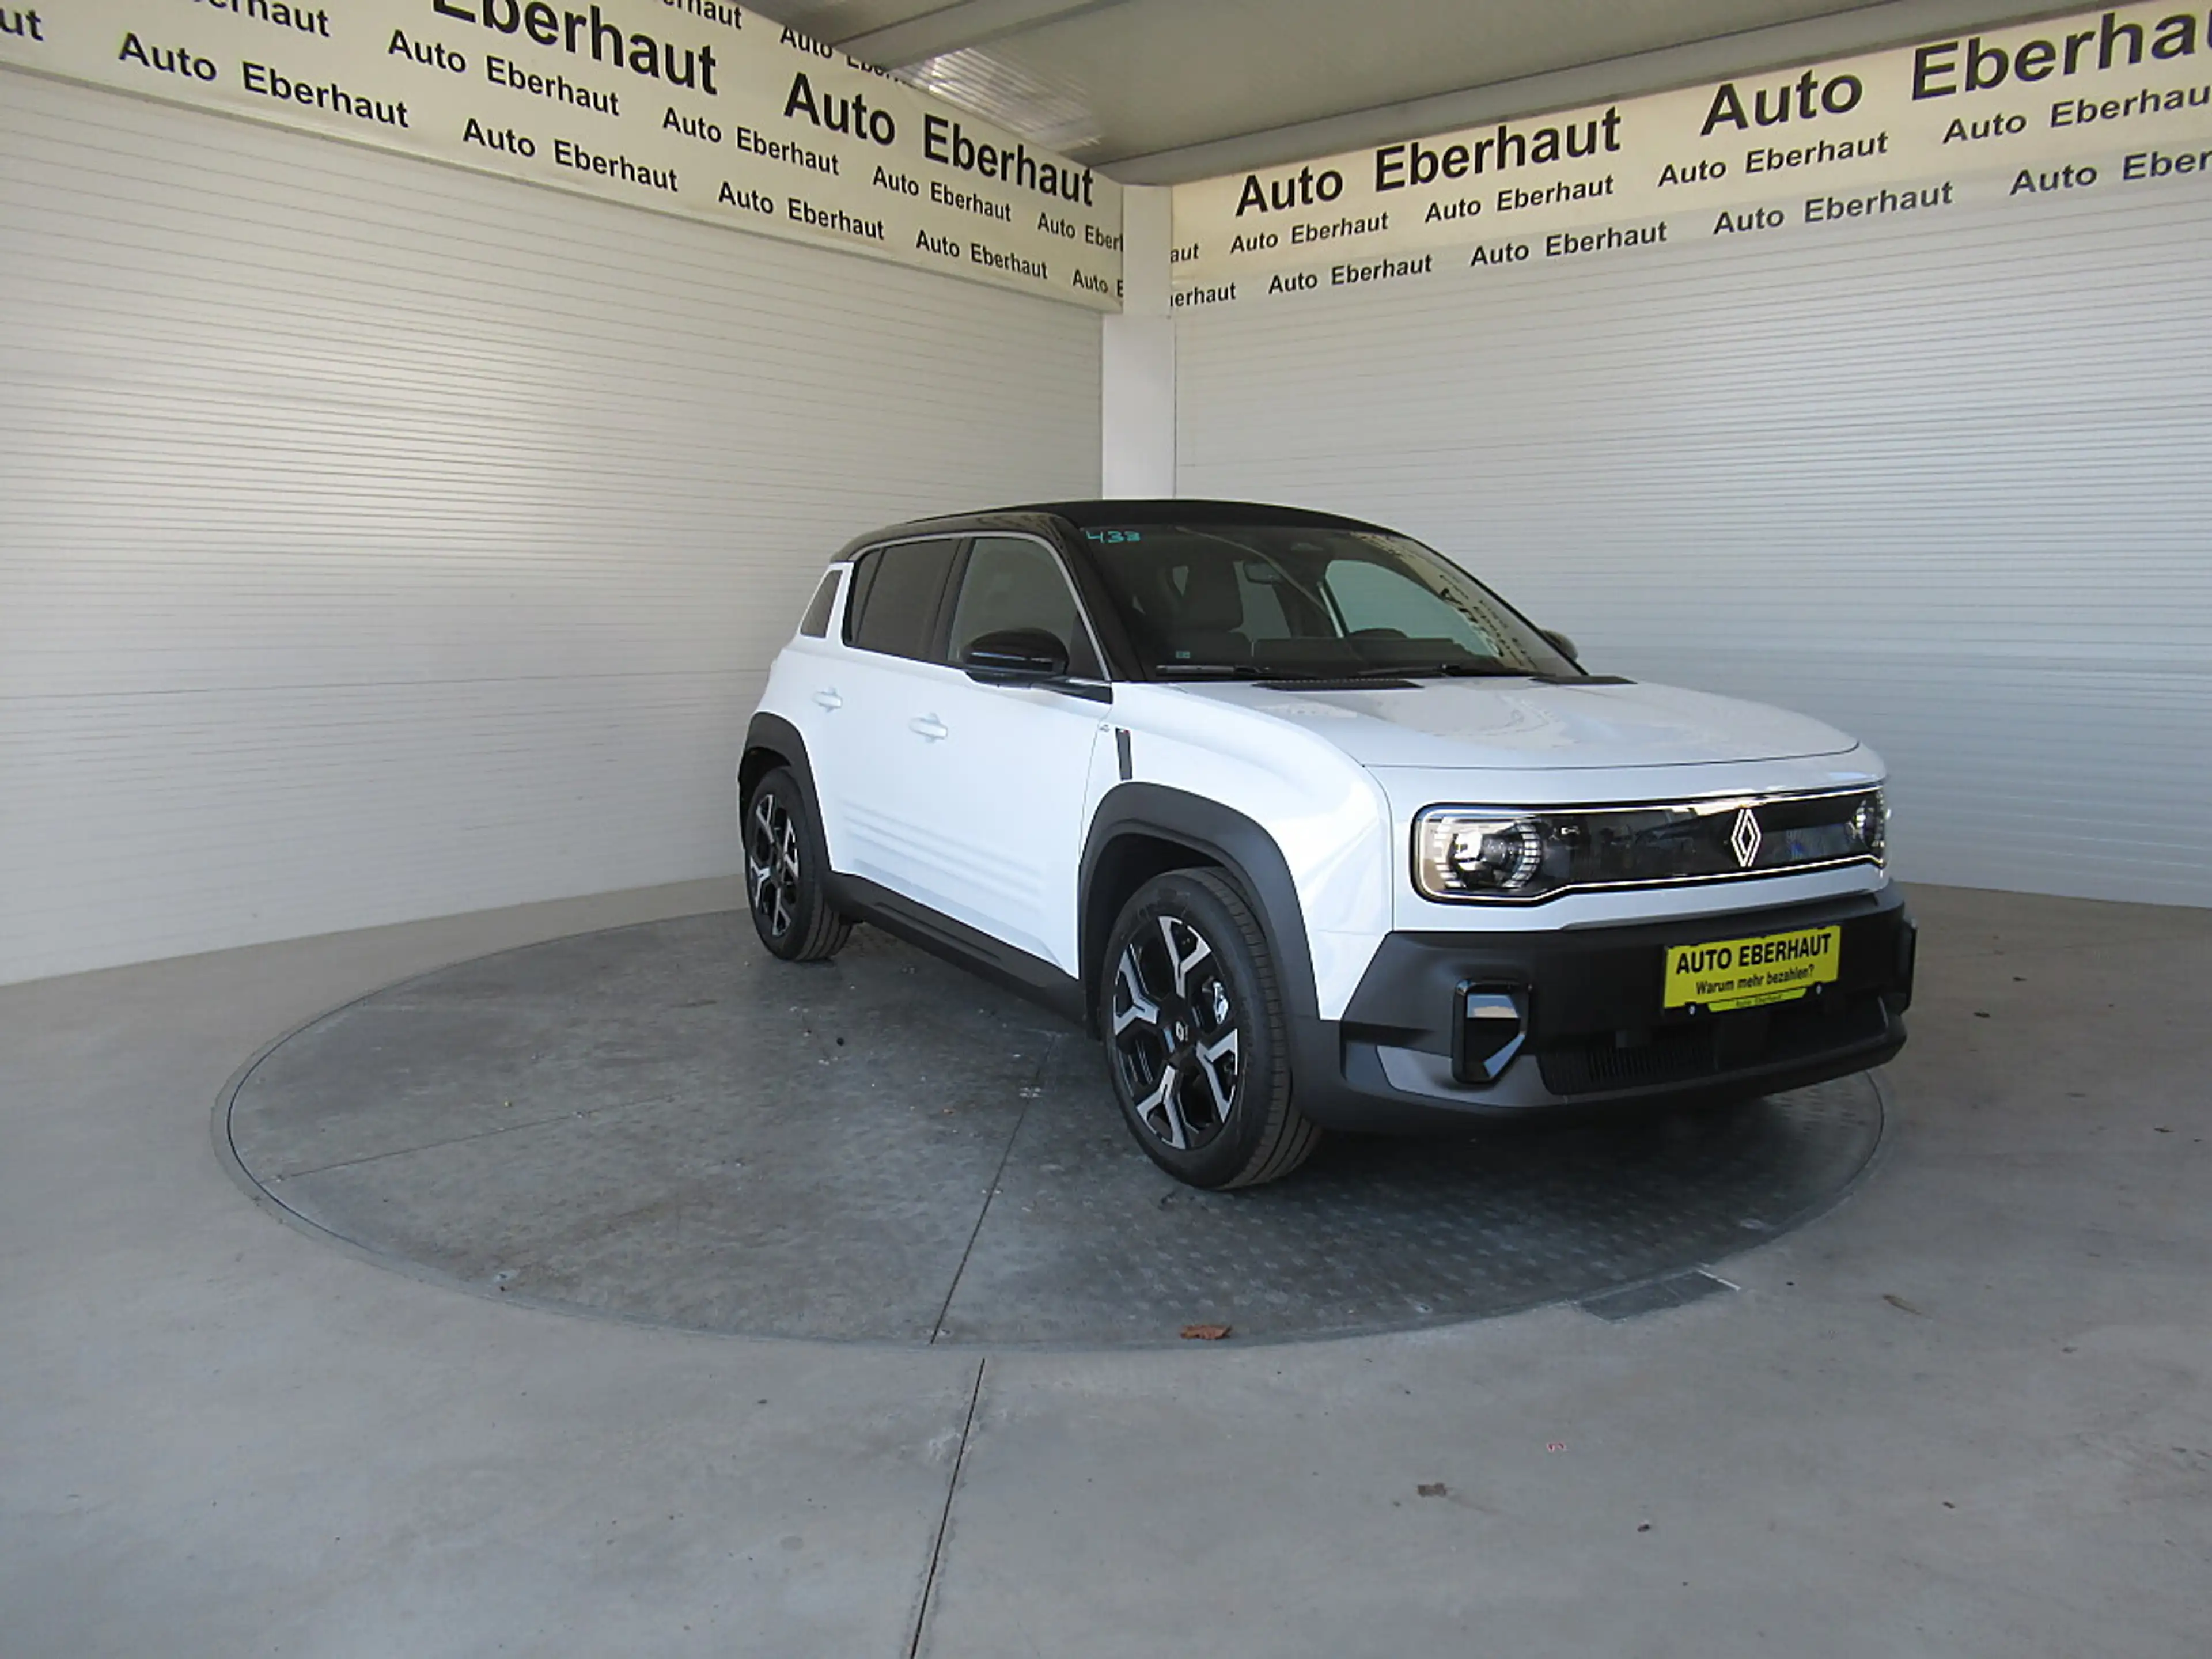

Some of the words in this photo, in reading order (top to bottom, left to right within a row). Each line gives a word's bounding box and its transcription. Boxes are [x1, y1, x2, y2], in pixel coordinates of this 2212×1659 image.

[118, 32, 218, 82] Auto
[241, 59, 410, 128] Eberhaut
[387, 29, 467, 73] Auto
[486, 54, 620, 116] Eberhaut
[1699, 69, 1863, 136] Auto
[1912, 10, 2212, 101] Eberha
[463, 118, 536, 158] Auto
[553, 138, 679, 192] Eberhaut
[662, 106, 722, 143] Auto
[736, 125, 840, 176] Eberhaut
[783, 71, 896, 147] Auto
[923, 113, 1094, 207] Eberhaut
[1942, 112, 2028, 145] Auto
[1234, 165, 1343, 217] Auto
[1374, 106, 1622, 192] Eberhaut
[1657, 158, 1727, 187] Auto
[1745, 130, 1889, 175] Eberhaut
[2008, 164, 2099, 196] Auto
[718, 180, 774, 215] Auto
[787, 196, 885, 241] Eberhaut
[872, 165, 920, 197] Auto
[930, 180, 1012, 222] Eberhaut
[1424, 196, 1482, 224] Auto
[1496, 173, 1615, 212] Eberhaut
[1713, 209, 1786, 235] Auto
[1803, 180, 1954, 223] Eberhaut
[1037, 211, 1076, 240] Auto
[1229, 229, 1279, 255] Auto
[1290, 211, 1389, 245] Eberhaut
[1469, 243, 1531, 267] Auto
[1545, 218, 1668, 257] Eberhaut
[915, 229, 961, 258] Auto
[971, 243, 1048, 280] Eberhaut
[1072, 268, 1109, 293] Auto
[1267, 270, 1319, 296] Auto
[1330, 253, 1433, 286] Eberhaut
[1676, 948, 1732, 975] AUTO
[1738, 933, 1831, 967] EBERHAUT
[1695, 980, 1734, 995] Warum
[1737, 974, 1764, 990] mehr
[1766, 964, 1815, 984] bezahlen?
